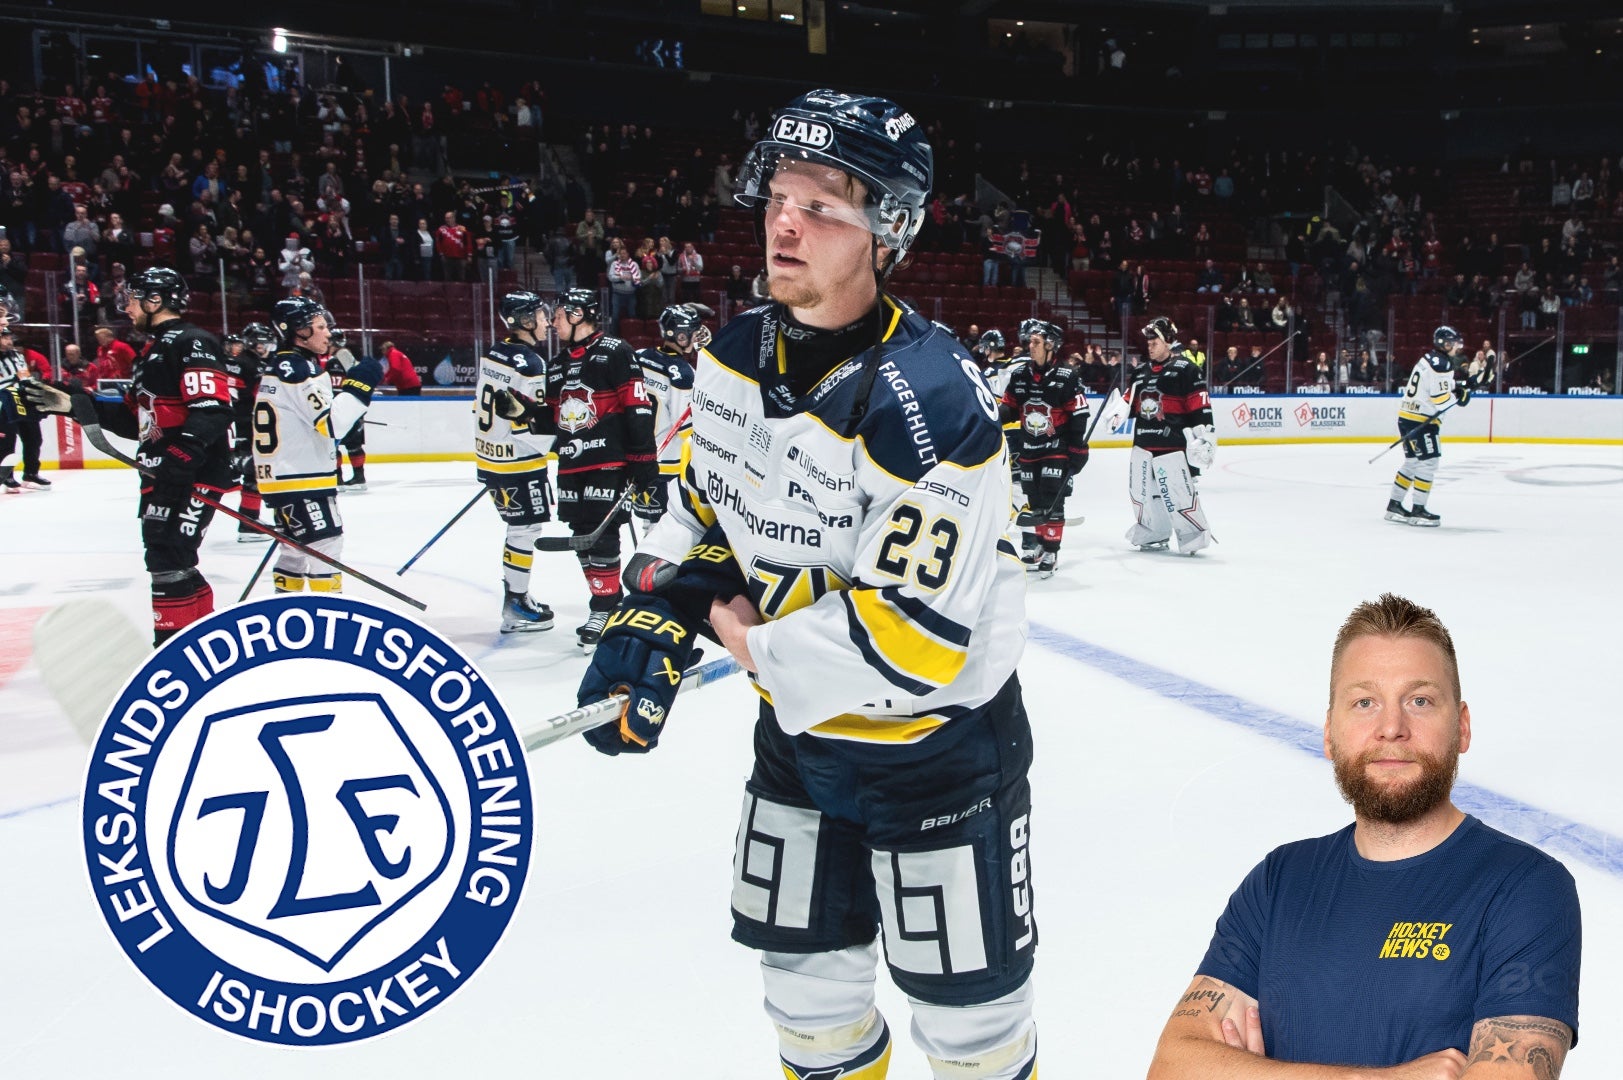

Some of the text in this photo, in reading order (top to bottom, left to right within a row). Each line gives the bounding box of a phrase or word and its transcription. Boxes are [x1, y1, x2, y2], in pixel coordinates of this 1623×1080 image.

[777, 118, 828, 147] EAB
[759, 312, 771, 368] WELLNESS
[766, 320, 778, 357] NORDIC
[184, 371, 216, 396] 95
[331, 376, 343, 386] 17
[878, 361, 938, 466] FAGERHULT
[1250, 407, 1283, 420] ROCK
[1311, 407, 1346, 419] ROCK
[797, 450, 855, 492] Liljedahl
[528, 480, 546, 515] LEBA
[584, 486, 615, 500] MAXI
[1158, 476, 1175, 513] bravida
[723, 484, 822, 548] Huqvarna
[875, 503, 960, 590] 23
[920, 796, 993, 831] BAUER
[1009, 813, 1034, 952] LEBA
[1388, 922, 1454, 940] HOCKEY
[1379, 939, 1447, 959] NEWS SE
